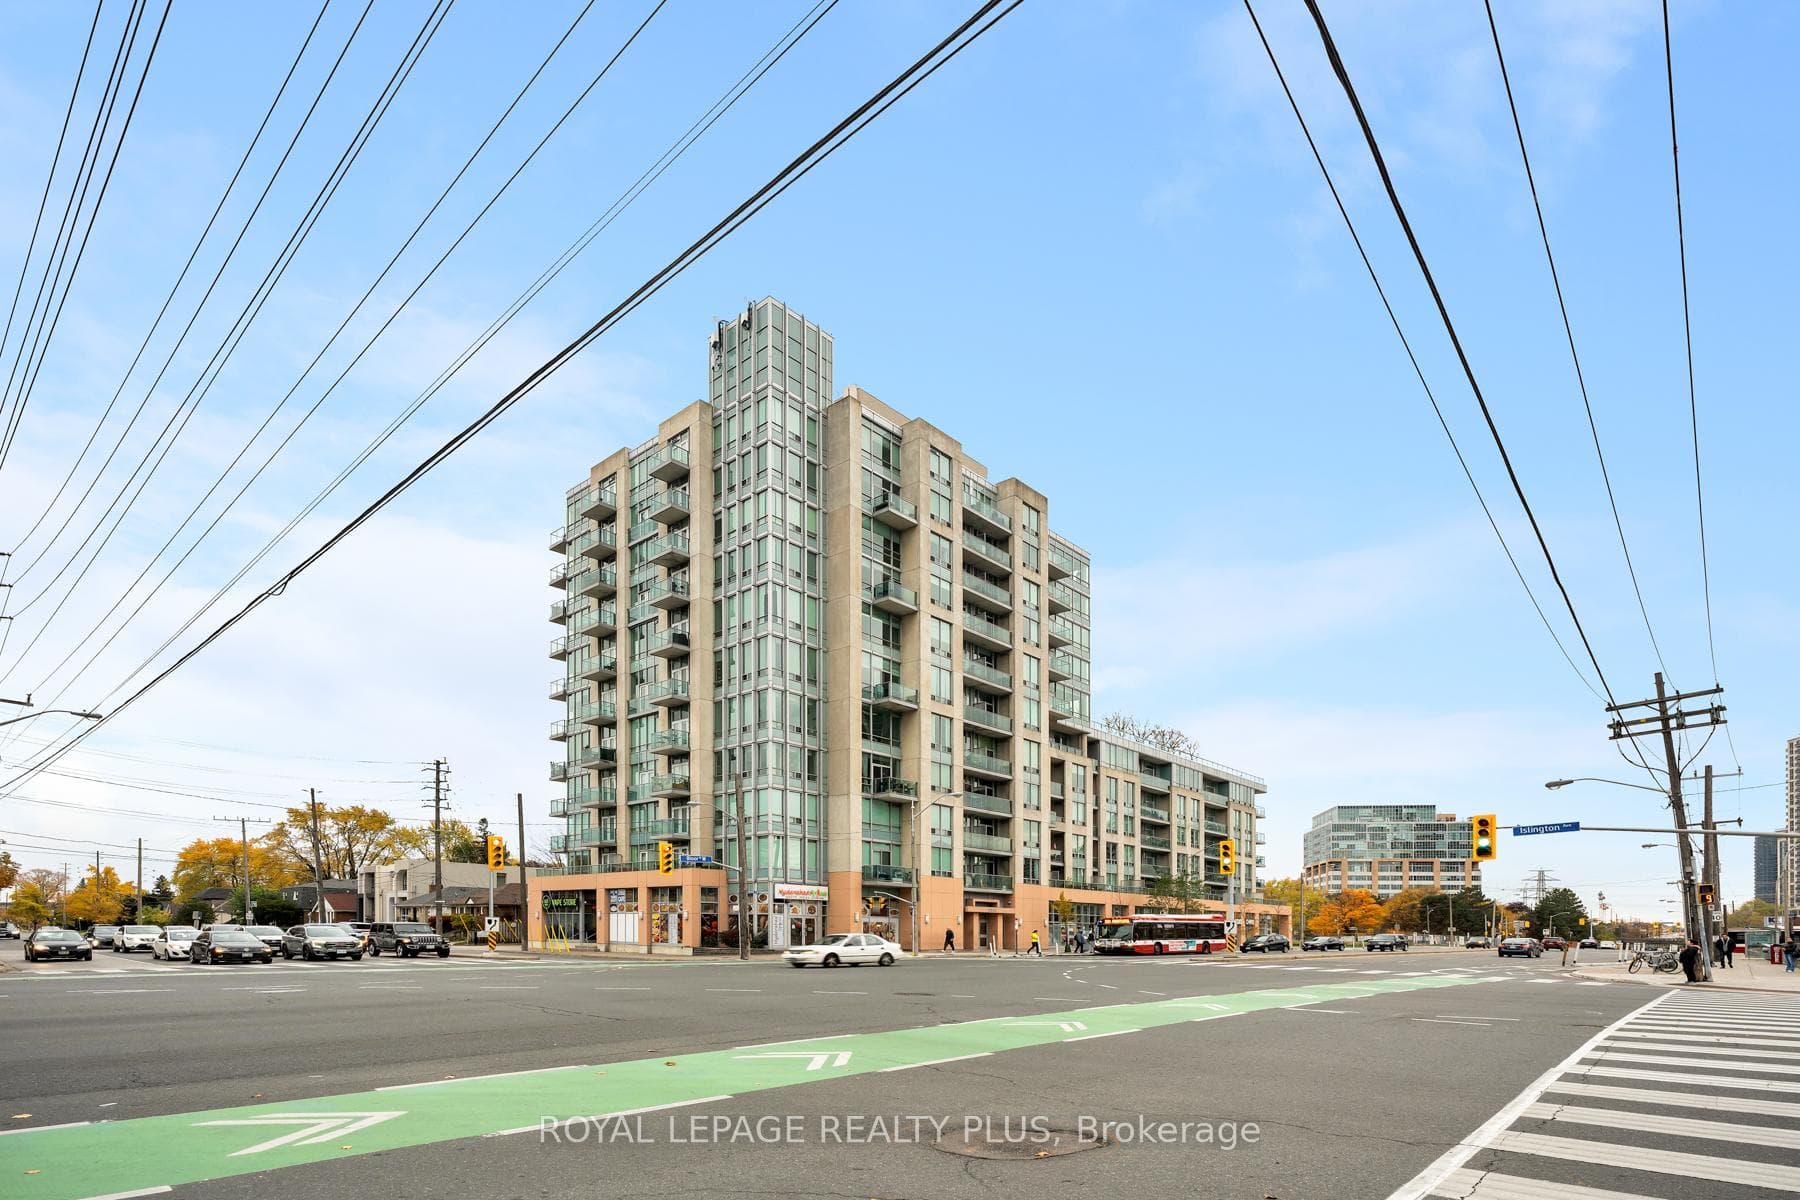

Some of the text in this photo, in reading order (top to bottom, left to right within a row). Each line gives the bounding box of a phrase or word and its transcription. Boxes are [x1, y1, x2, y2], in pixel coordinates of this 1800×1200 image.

[1520, 825, 1560, 834] Islington
[563, 898, 577, 906] STORE
[1706, 895, 1712, 903] 9
